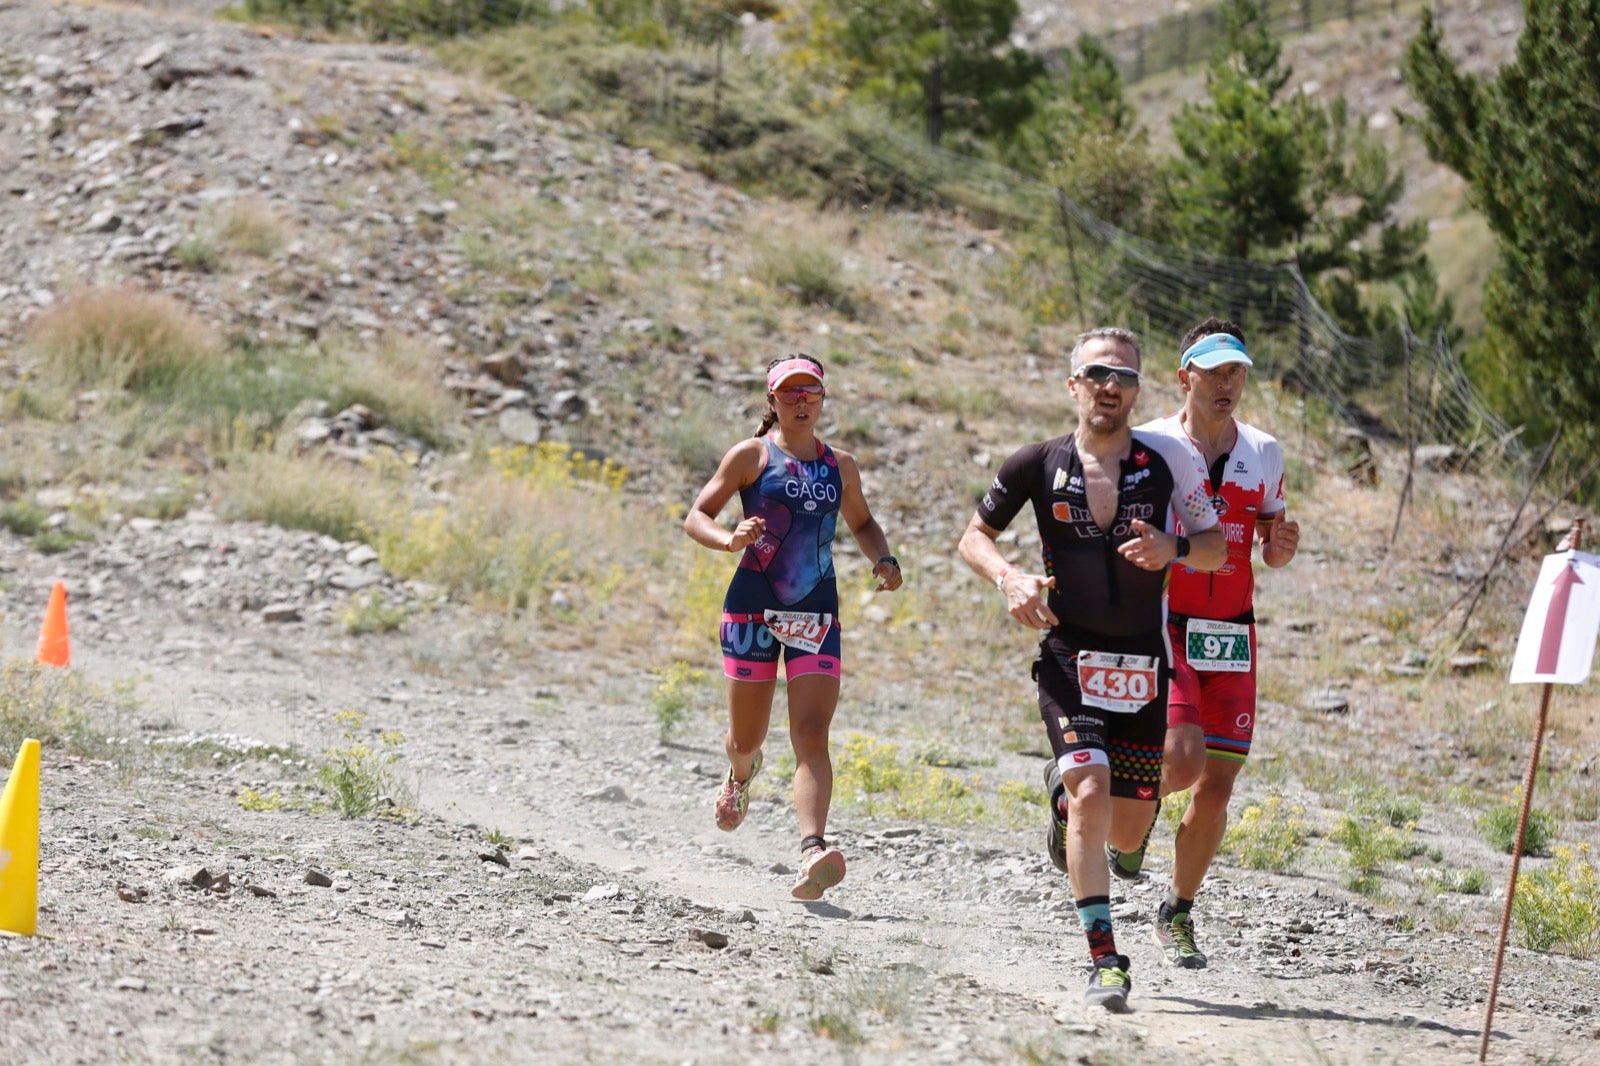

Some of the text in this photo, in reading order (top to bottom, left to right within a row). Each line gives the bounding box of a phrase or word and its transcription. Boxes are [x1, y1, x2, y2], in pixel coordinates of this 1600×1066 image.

[785, 480, 837, 502] GAGO
[1203, 635, 1236, 658] 97
[1087, 670, 1148, 699] 430
